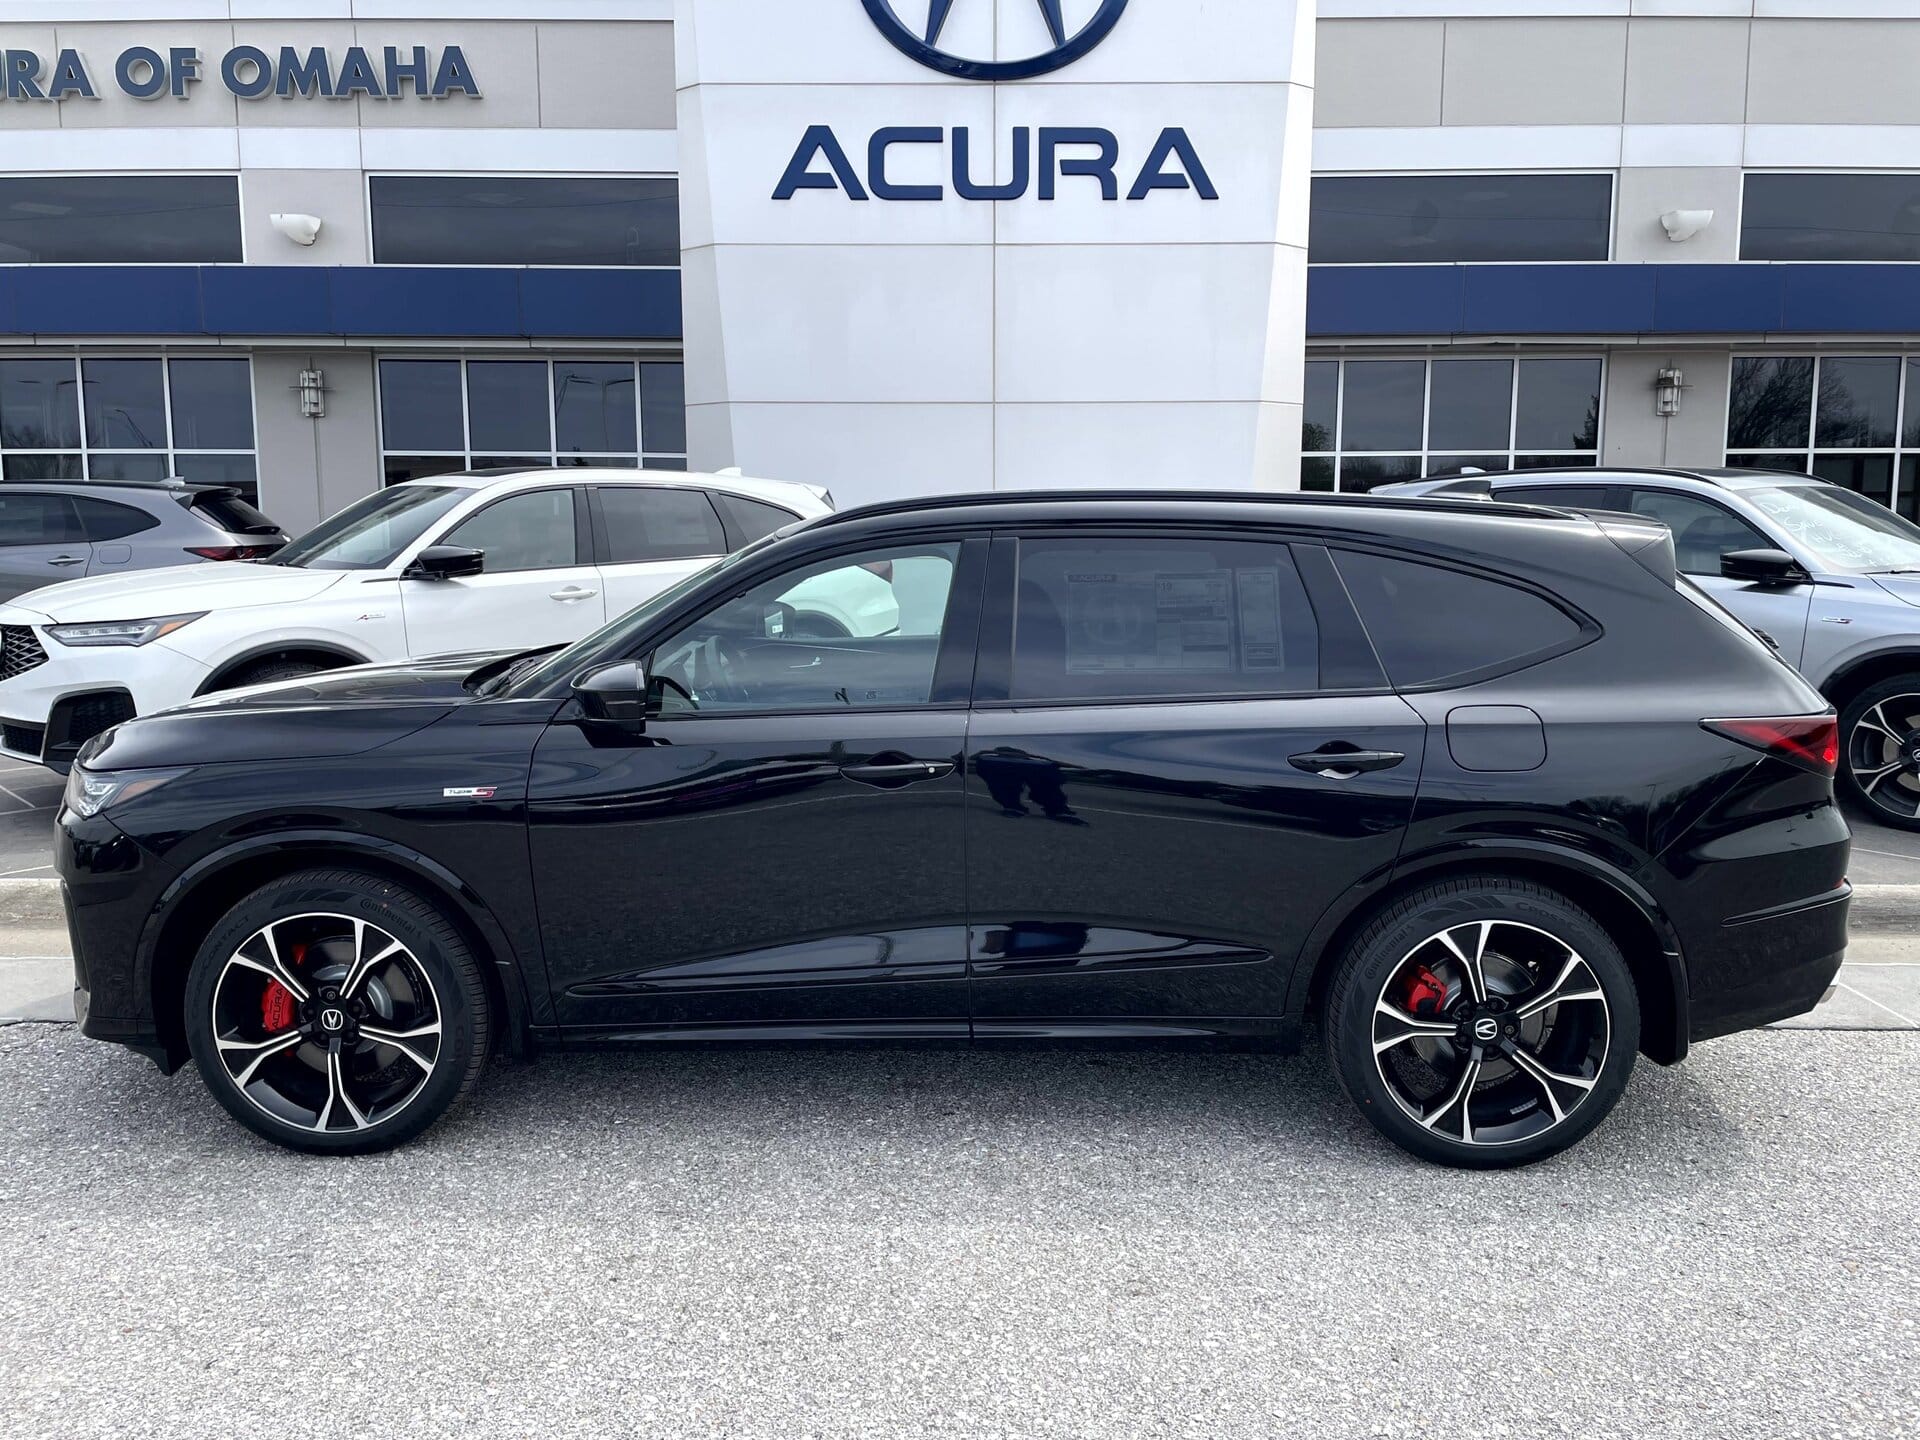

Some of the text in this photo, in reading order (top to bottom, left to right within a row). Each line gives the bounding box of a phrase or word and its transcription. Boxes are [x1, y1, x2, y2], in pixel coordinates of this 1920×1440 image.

[0, 45, 482, 98] RA OF OMAHA
[771, 125, 1219, 201] ACURA
[360, 898, 416, 934] Continental
[272, 988, 283, 1030] ACURA
